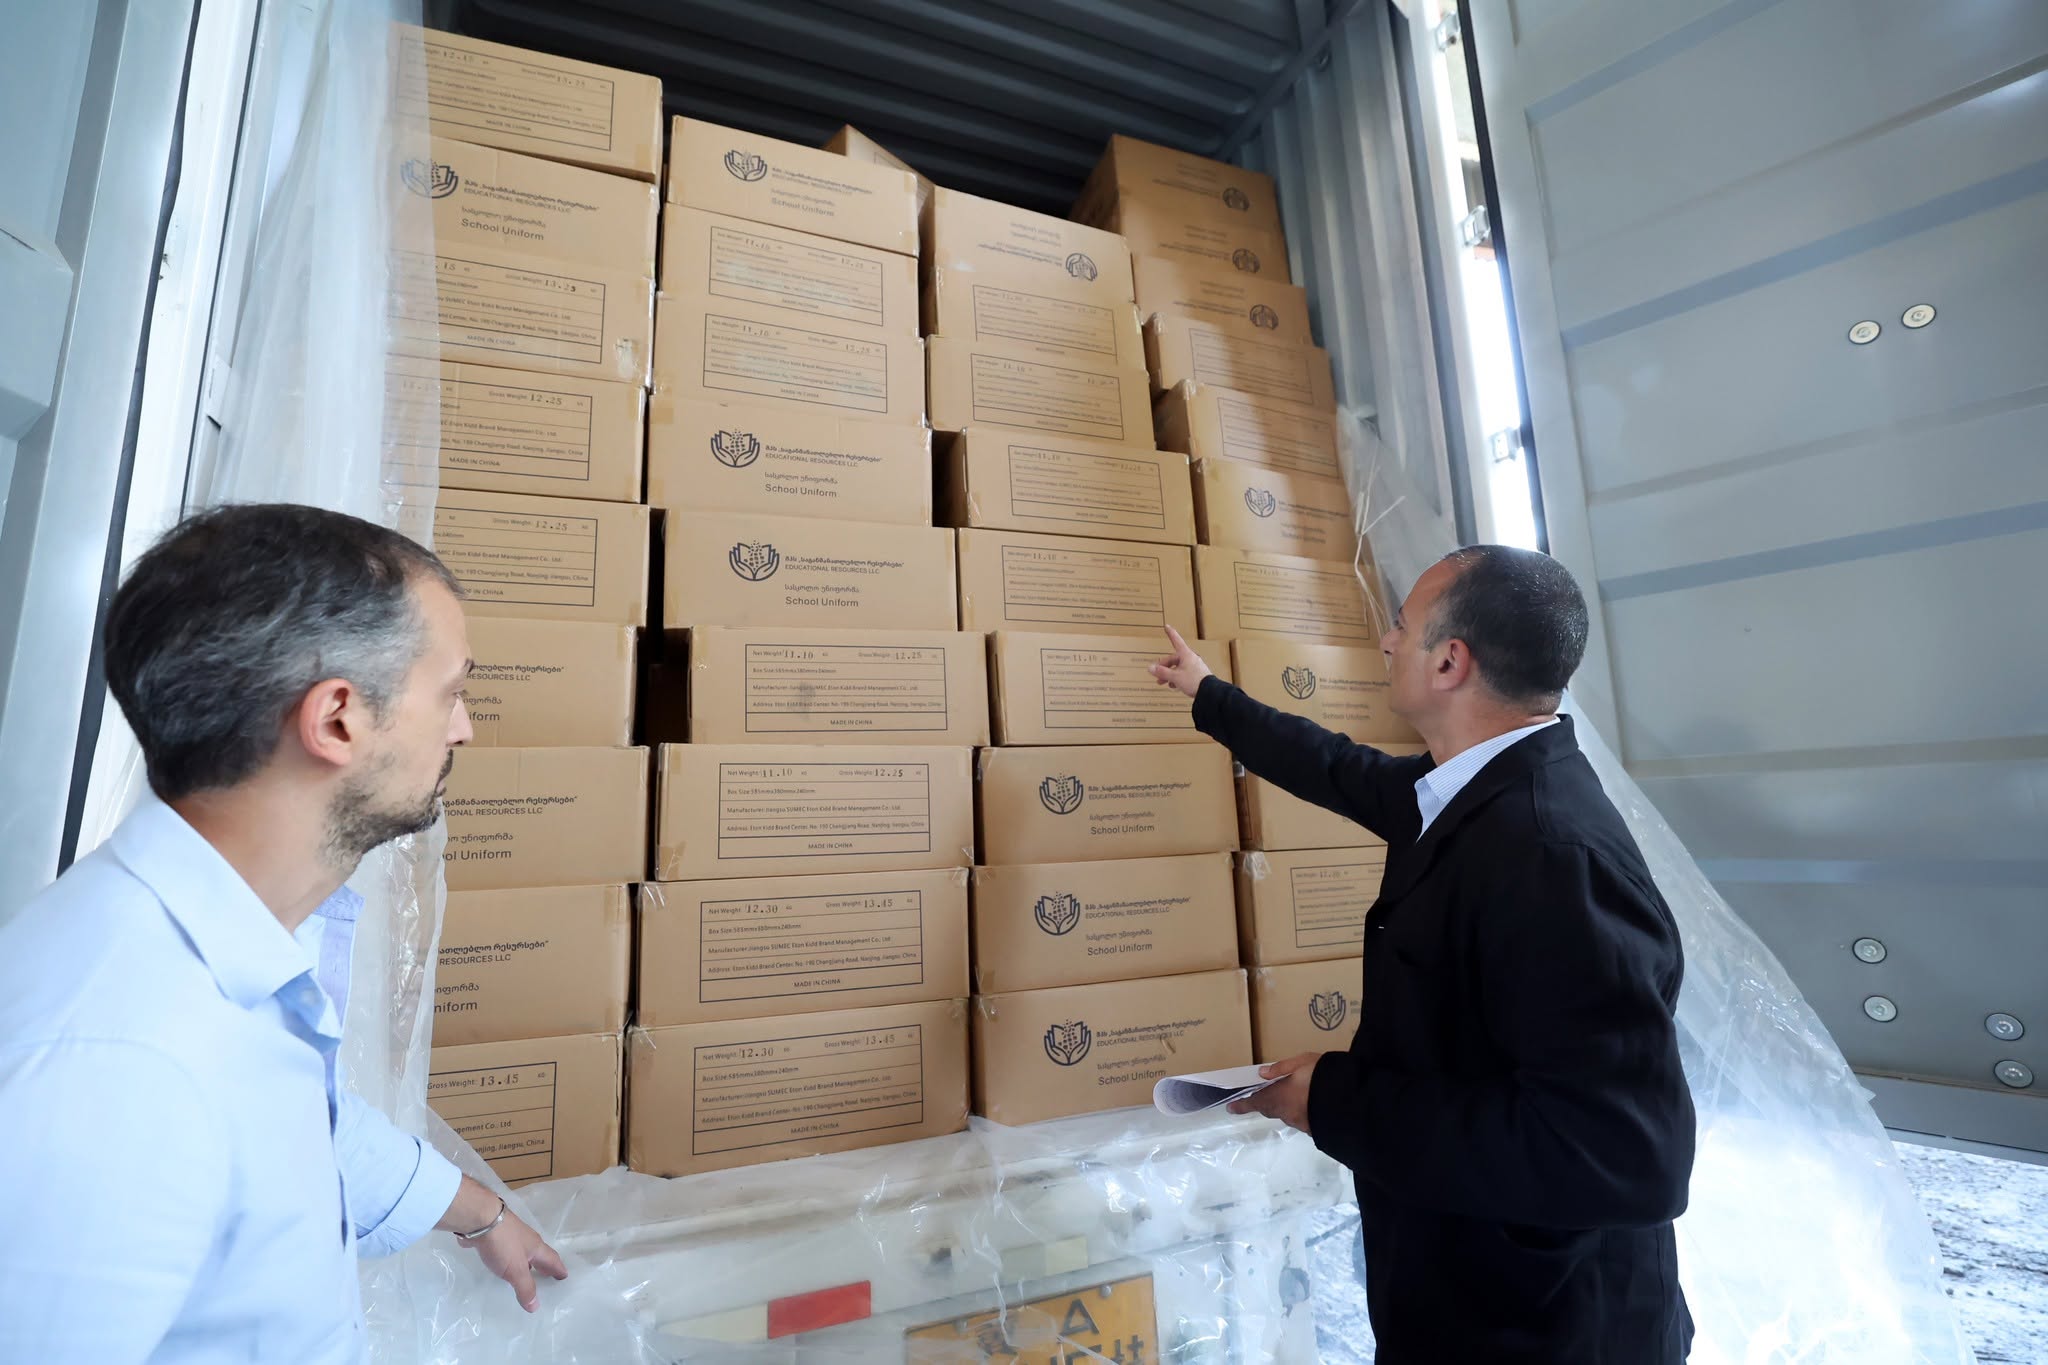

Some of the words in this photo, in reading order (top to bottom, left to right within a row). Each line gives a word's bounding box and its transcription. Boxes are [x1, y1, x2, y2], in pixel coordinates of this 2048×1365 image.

[463, 188, 513, 202] EDUCATIONAL
[515, 198, 557, 210] RESOURCES
[801, 203, 835, 217] Uniform
[461, 218, 499, 233] School
[502, 226, 545, 241] Uniform
[765, 453, 808, 462] EDUCATIONAL
[810, 458, 846, 466] RESOURCES
[765, 484, 798, 494] School
[800, 487, 837, 498] Uniform
[785, 564, 829, 572] EDUCATIONAL
[831, 566, 867, 574] RESOURCES
[785, 596, 818, 606] School
[821, 598, 859, 607] Uniform
[466, 673, 514, 681] RESOURCES
[469, 711, 500, 721] iform
[875, 768, 903, 777] 12.25
[444, 808, 473, 817] TIONAL
[475, 807, 526, 816] RESOURCES
[1091, 826, 1120, 835] School
[1122, 825, 1155, 833] Uniform
[460, 849, 512, 861] Uniform
[746, 905, 778, 913] 12.30
[1086, 911, 1125, 919] EDUCATIONAL
[836, 938, 870, 946] Management
[1088, 945, 1117, 956] School
[1119, 944, 1153, 953] Uniform
[439, 954, 493, 966] RESOURCES
[495, 953, 511, 962] LLC
[434, 1001, 478, 1013] niform
[1097, 1037, 1137, 1047] EDUCATIONAL
[742, 1048, 773, 1058] 12.30
[1098, 1074, 1129, 1086] School
[1132, 1070, 1167, 1081] Uniform
[427, 1082, 448, 1090] Gross
[767, 1088, 789, 1096] SUMEC
[791, 1126, 809, 1134] MADE
[818, 1122, 839, 1130] CHINA
[526, 1139, 545, 1147] China
